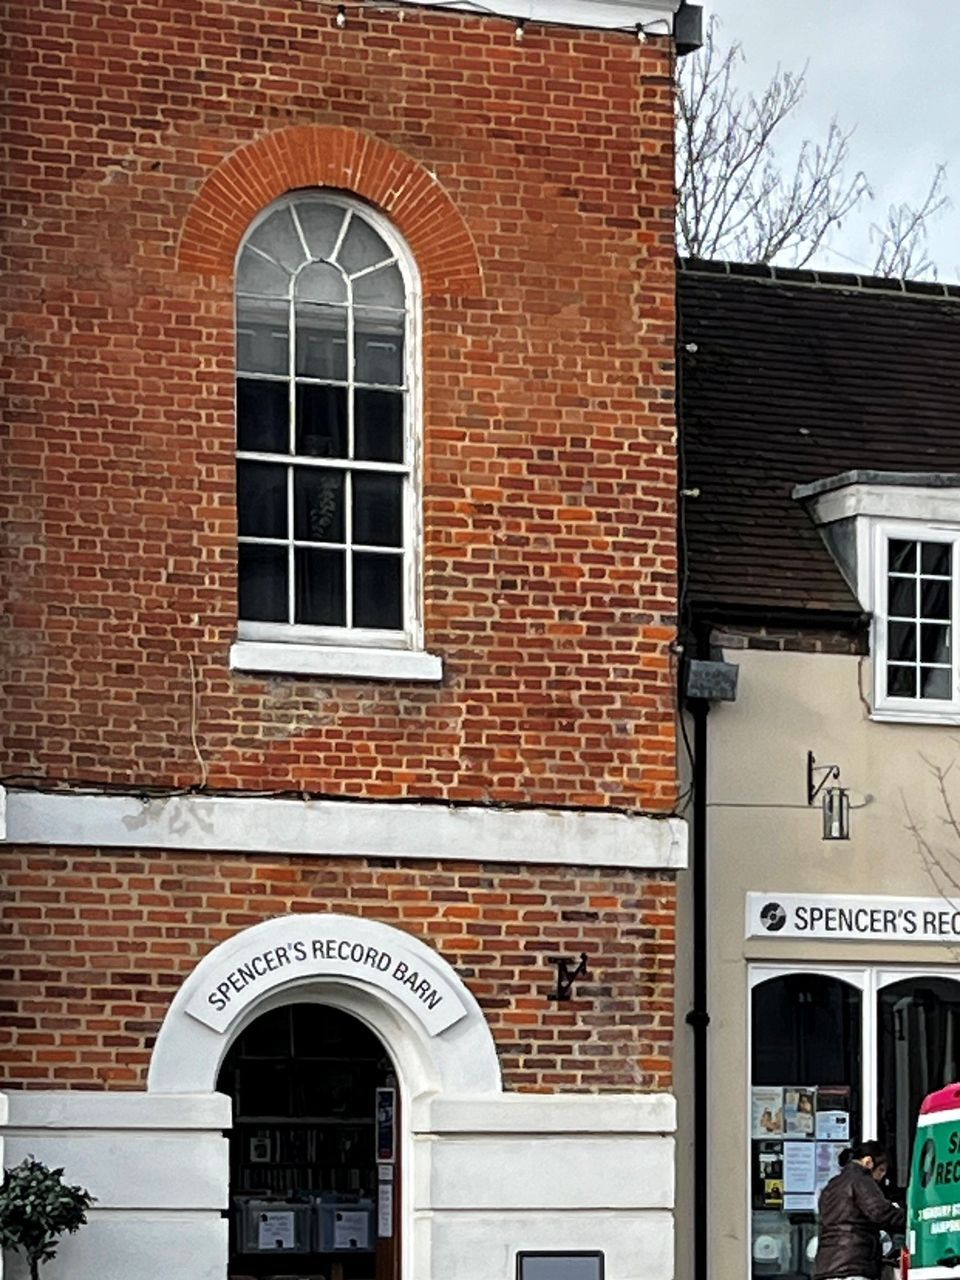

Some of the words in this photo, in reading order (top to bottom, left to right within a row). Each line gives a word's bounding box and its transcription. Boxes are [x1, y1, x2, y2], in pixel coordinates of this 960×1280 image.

[794, 907, 917, 935] SPENCER'S
[208, 941, 307, 1011] SPENCER'S
[312, 939, 392, 972] RECORD
[392, 961, 443, 1010] BARN
